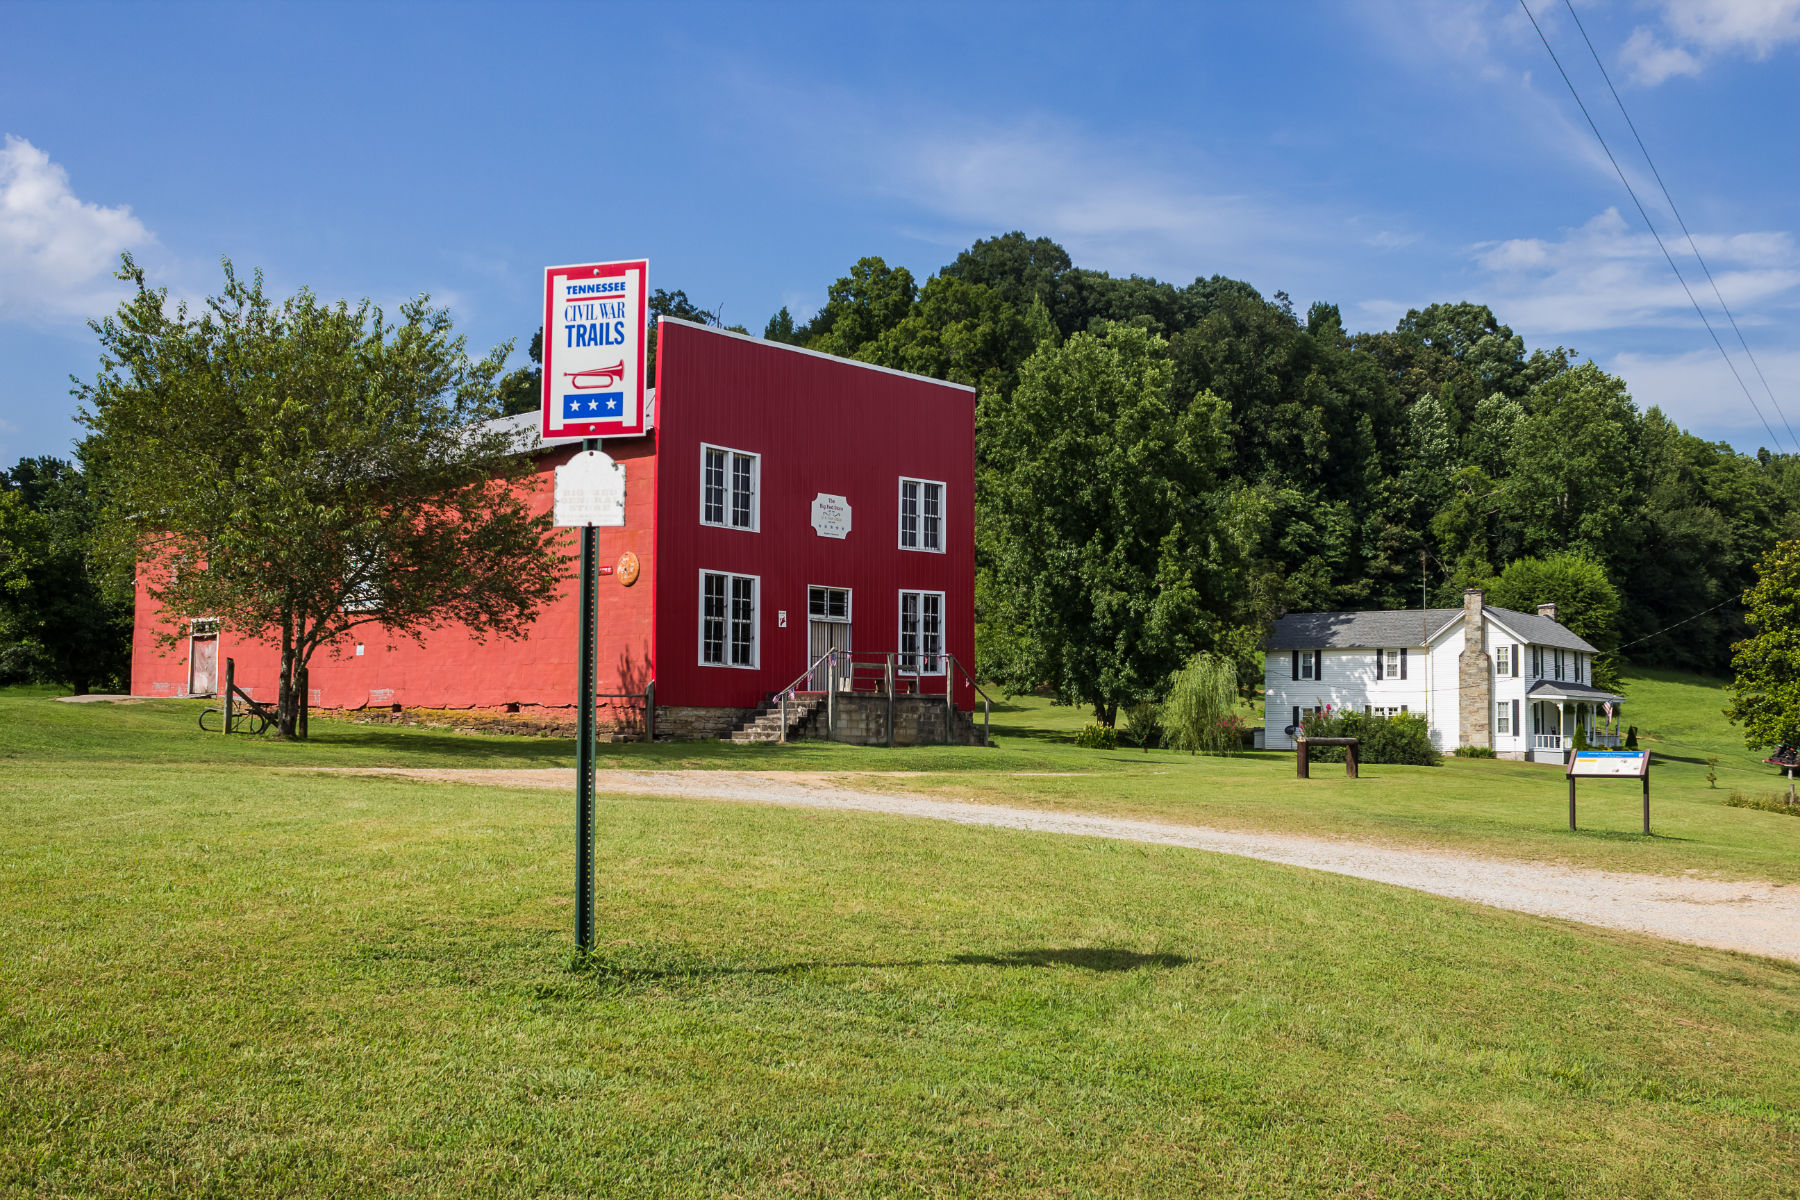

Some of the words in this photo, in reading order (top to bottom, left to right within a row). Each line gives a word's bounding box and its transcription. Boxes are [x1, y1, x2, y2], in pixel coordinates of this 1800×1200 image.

[566, 281, 626, 295] TENNESSEE
[565, 303, 598, 322] CIVIL
[599, 301, 626, 320] WAR
[565, 320, 625, 348] TRAILS
